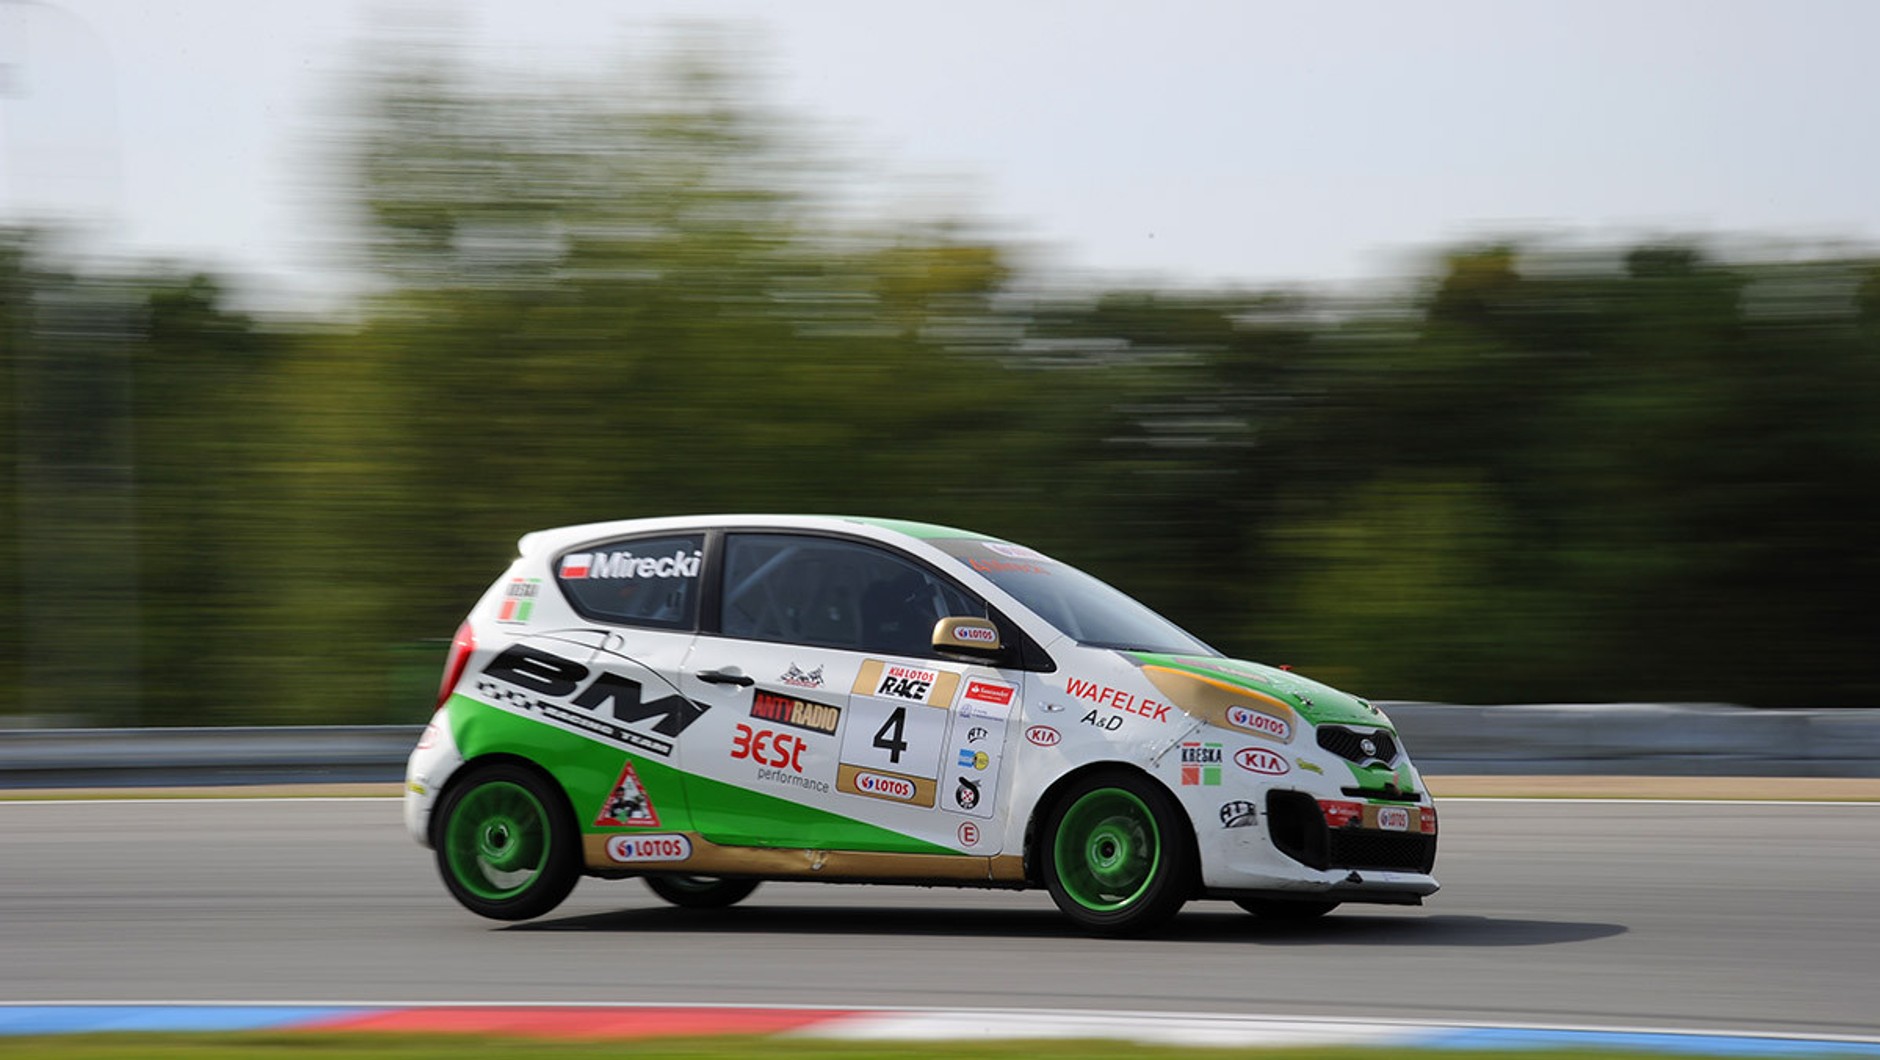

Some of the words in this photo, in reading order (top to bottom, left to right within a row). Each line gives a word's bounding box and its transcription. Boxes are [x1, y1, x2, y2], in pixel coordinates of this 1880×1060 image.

[590, 551, 702, 578] Mirecki
[968, 629, 992, 640] LOTOS
[905, 669, 935, 682] LOTOS
[481, 643, 712, 738] BM
[878, 676, 931, 700] RACE
[1066, 677, 1173, 723] WAFELEK
[1249, 714, 1285, 735] LOTOS
[873, 706, 908, 764] 4
[1032, 728, 1056, 743] KIA
[1181, 748, 1223, 763] KRESKA
[1245, 753, 1282, 772] KIA
[757, 768, 830, 793] performance
[875, 778, 909, 796] LOTOS
[963, 827, 975, 842] E
[636, 839, 682, 858] LOTOS
